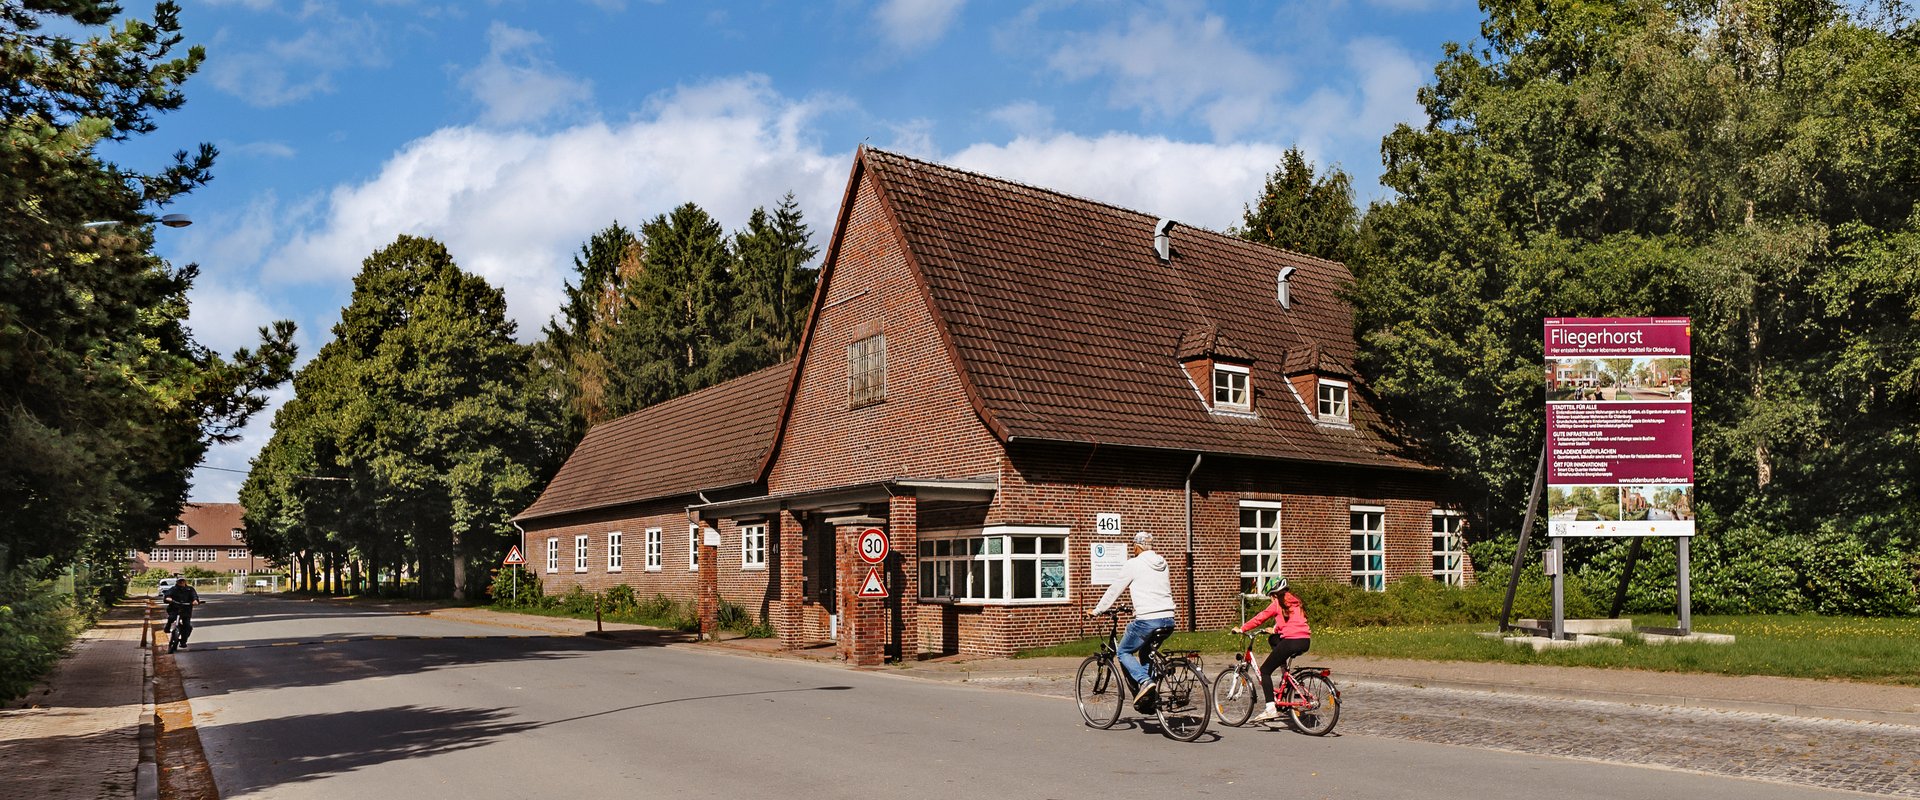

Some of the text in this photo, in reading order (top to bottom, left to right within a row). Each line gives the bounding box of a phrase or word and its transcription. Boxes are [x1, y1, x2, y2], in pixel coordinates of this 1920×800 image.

[1551, 328, 1643, 348] Fliegerhorst
[1098, 518, 1120, 531] 461
[865, 538, 882, 554] 30
